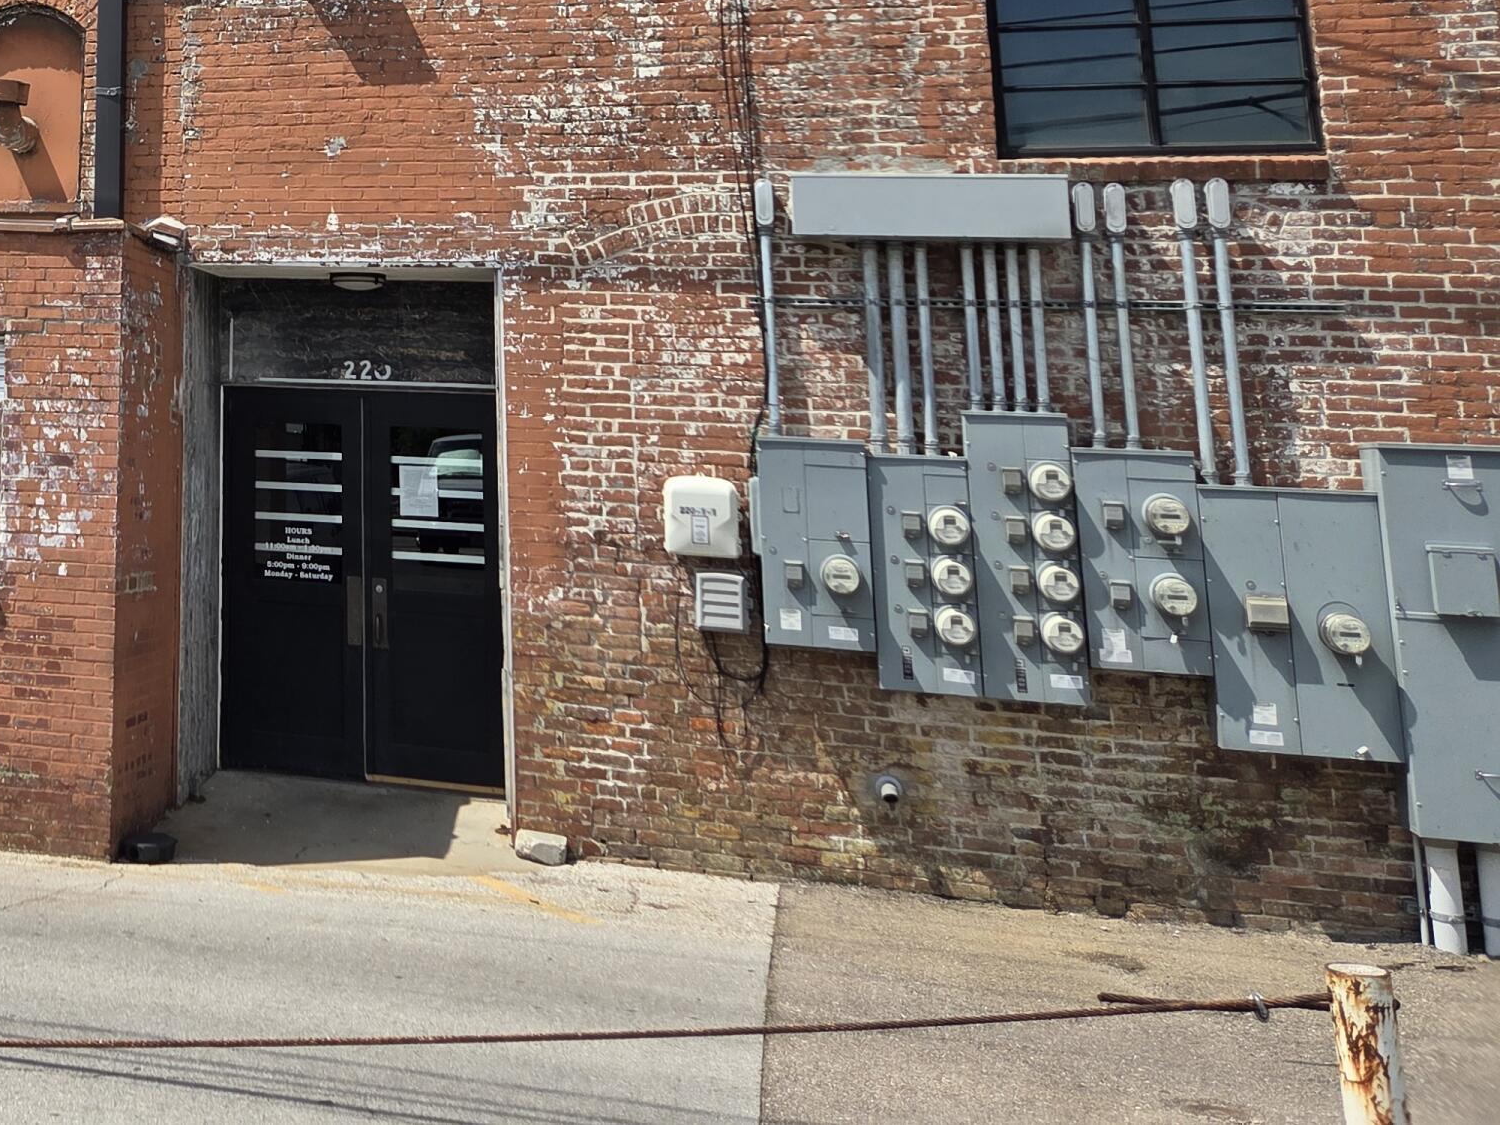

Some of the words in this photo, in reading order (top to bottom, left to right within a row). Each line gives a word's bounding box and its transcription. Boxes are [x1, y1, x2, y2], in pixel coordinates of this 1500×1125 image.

[285, 527, 312, 535] HOURS
[287, 536, 310, 544] Lunch
[286, 553, 312, 561] Dinner
[301, 562, 330, 572] 9:00pm
[264, 570, 293, 579] Monday
[299, 572, 333, 581] Saturday
